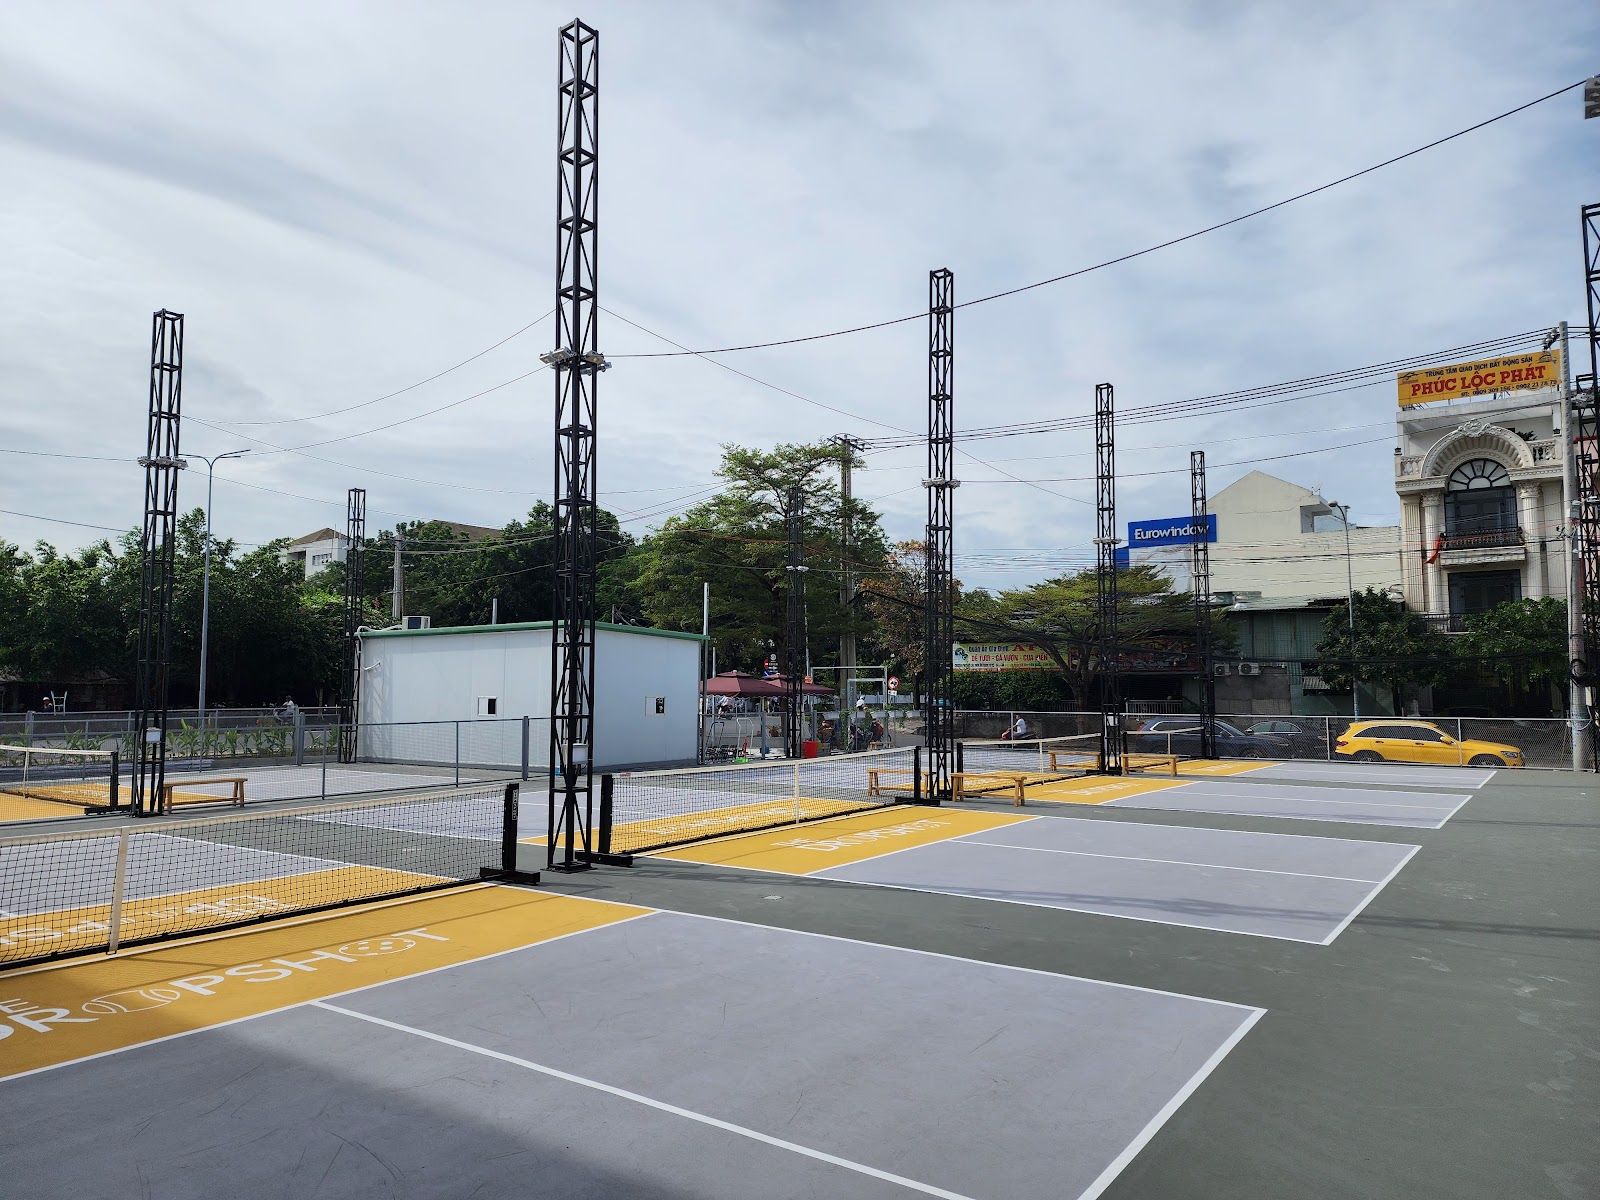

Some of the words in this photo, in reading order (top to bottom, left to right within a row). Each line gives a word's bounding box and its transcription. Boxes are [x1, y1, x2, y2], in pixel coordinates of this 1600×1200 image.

[1411, 376, 1457, 396] PHÚC
[1460, 371, 1497, 391] LỘC
[1500, 363, 1546, 384] PHÁT
